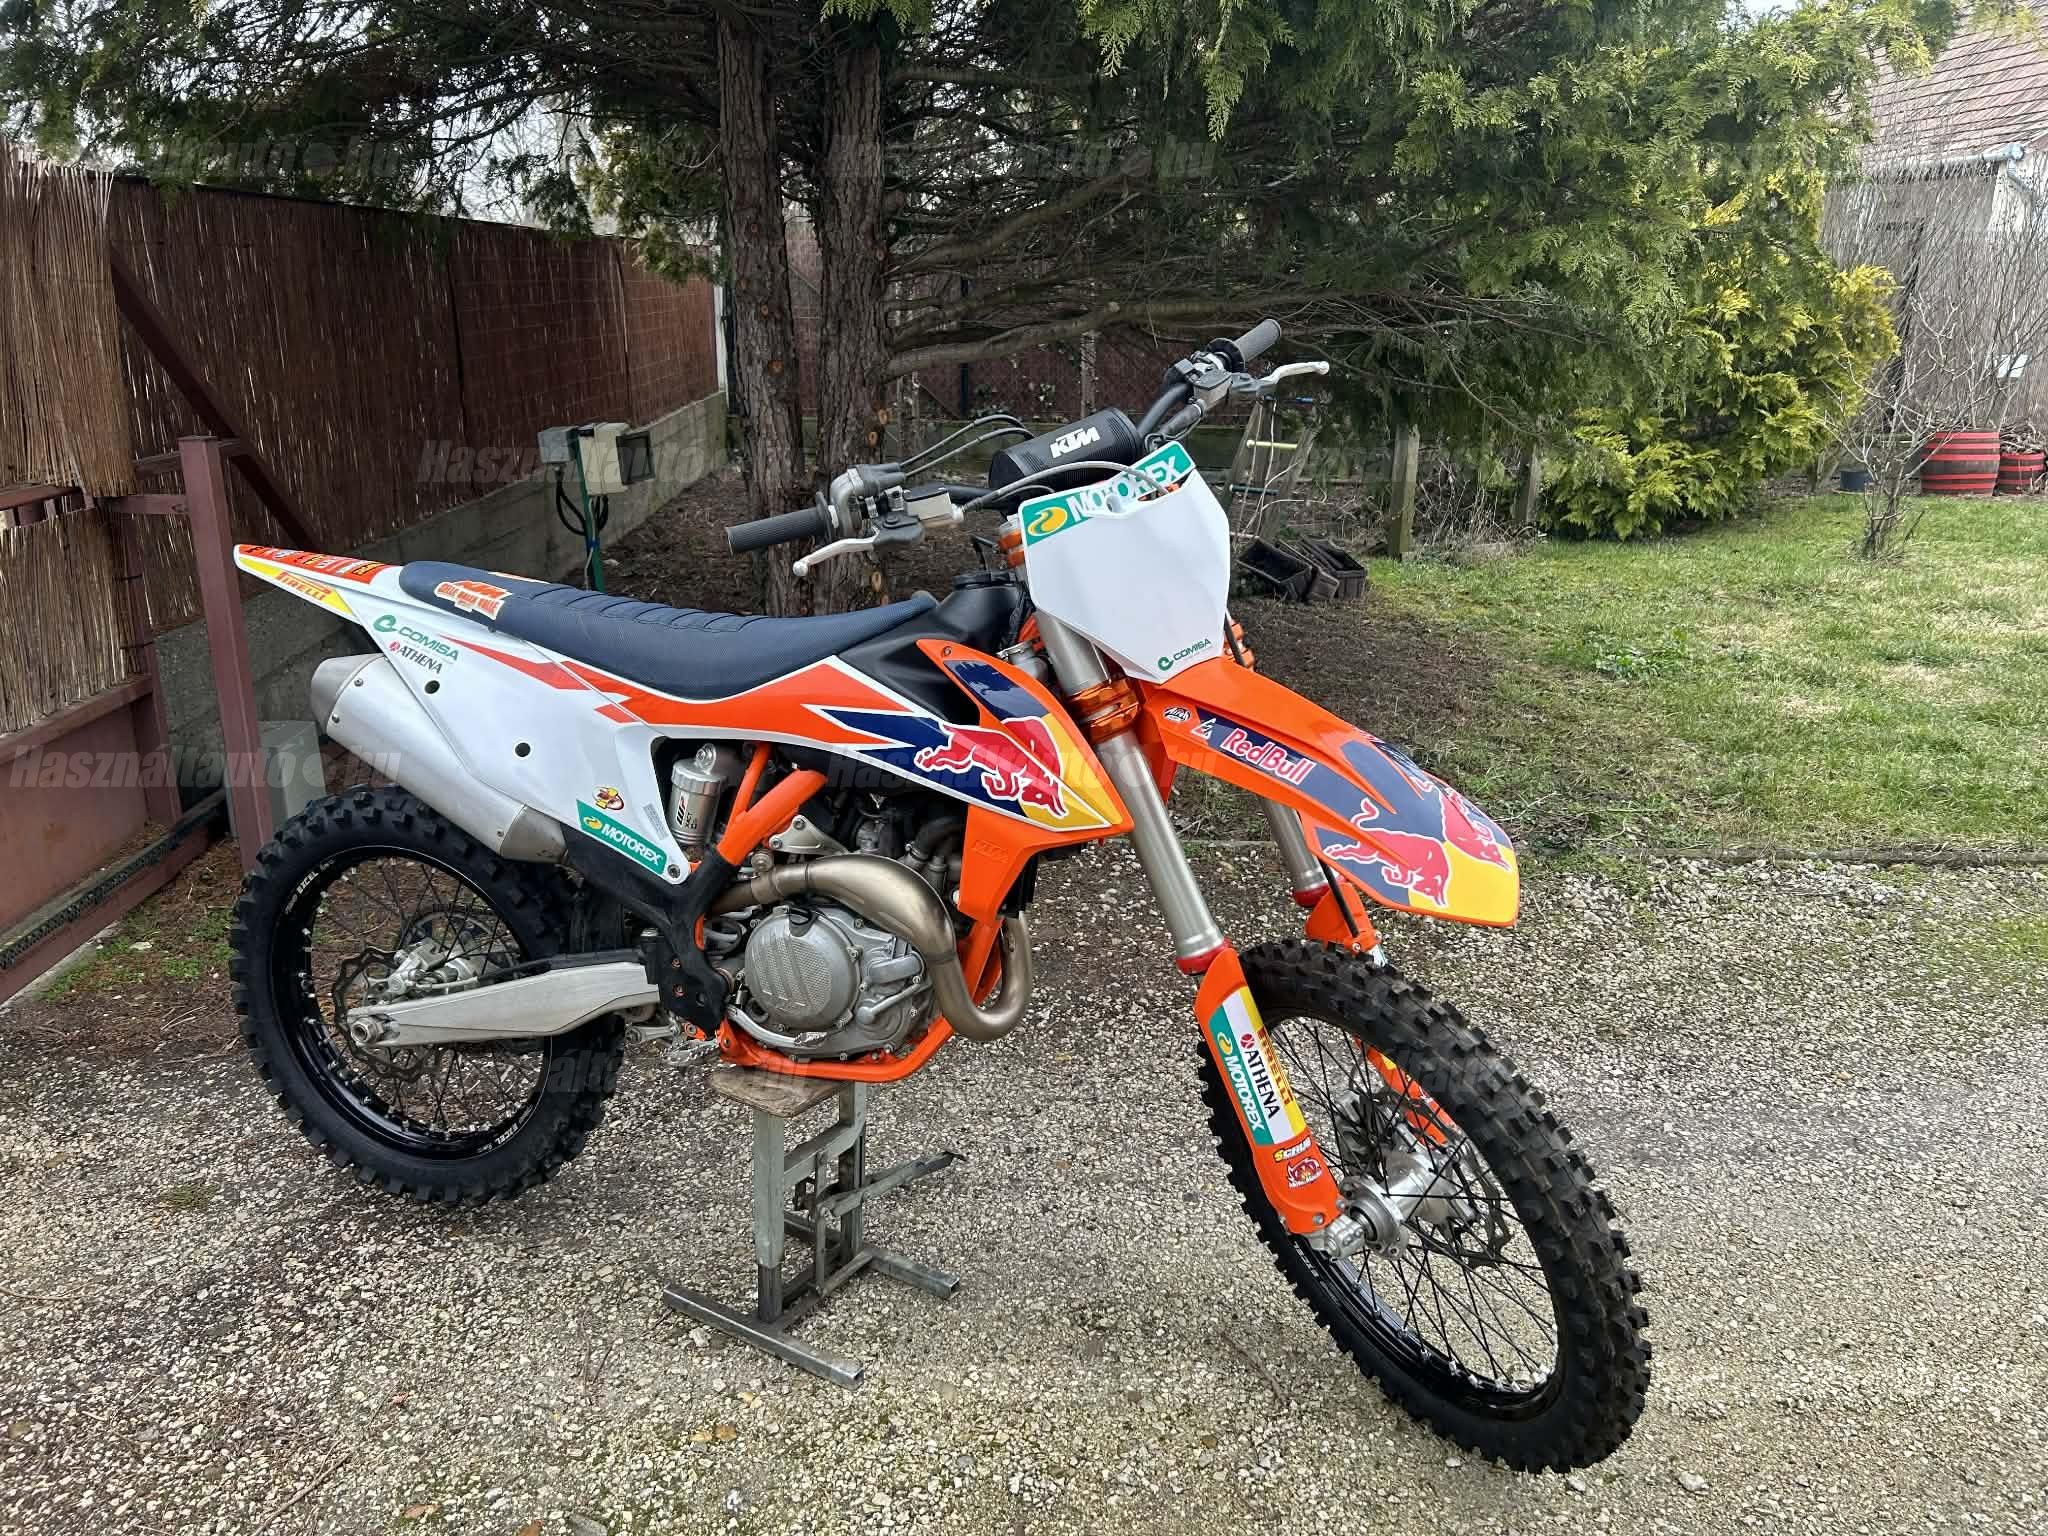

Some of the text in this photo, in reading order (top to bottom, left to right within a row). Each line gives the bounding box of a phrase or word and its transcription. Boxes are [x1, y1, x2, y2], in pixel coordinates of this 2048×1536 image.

[1050, 427, 1100, 459] KTM
[273, 571, 333, 601] PIRELLI
[399, 626, 459, 661] COMISA
[400, 645, 443, 675] ATHENA
[1173, 638, 1211, 661] COMISA
[601, 823, 664, 867] MOTOREX
[1256, 1024, 1295, 1105] PIRELLI
[1224, 1055, 1265, 1131] MOTOREX
[1245, 1049, 1281, 1119] ATHENA
